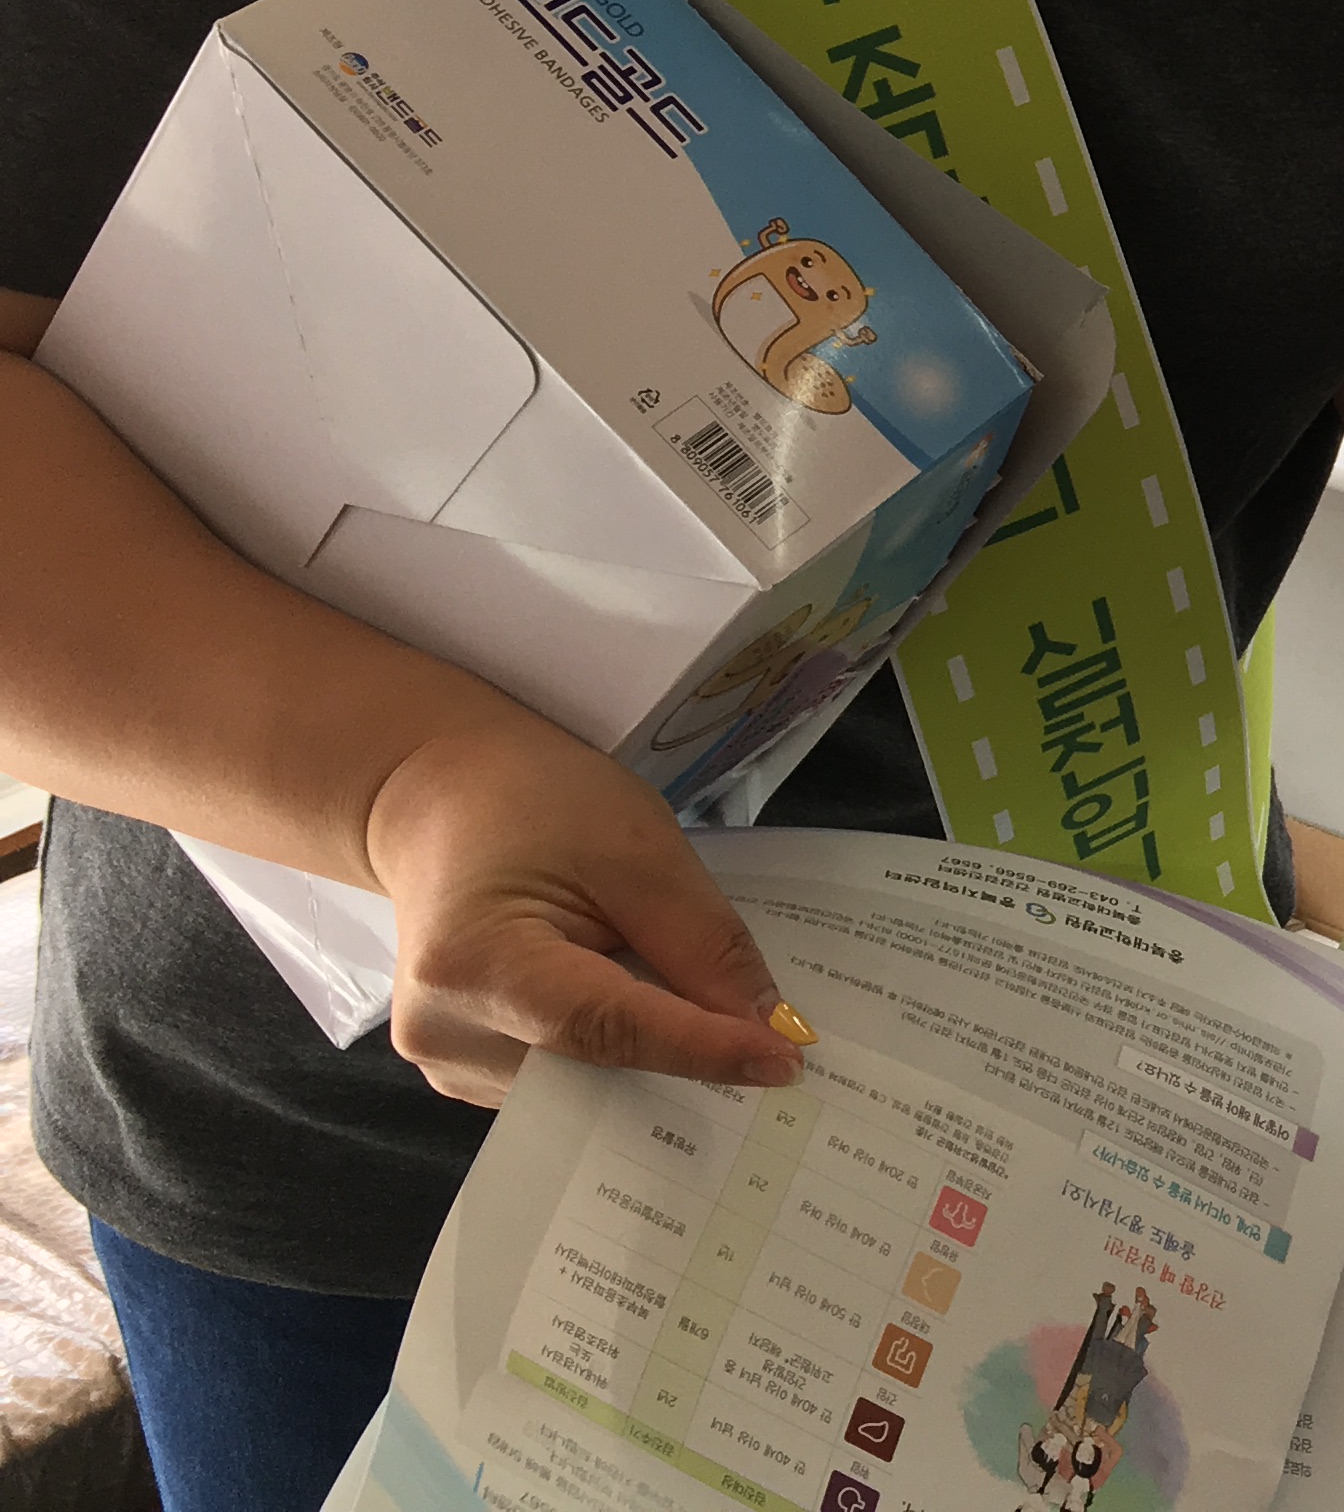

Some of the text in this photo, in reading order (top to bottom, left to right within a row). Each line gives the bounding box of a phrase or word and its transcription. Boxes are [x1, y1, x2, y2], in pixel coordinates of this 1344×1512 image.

[531, 46, 610, 126] BANDAGES
[669, 433, 759, 525] 8 809057 761061
[939, 852, 982, 872] 6567
[883, 864, 1017, 911] 충북지역암센터
[936, 861, 1144, 927] 충북대학교병원 건강검진센터
[1059, 911, 1189, 966] 충북대학교병원
[772, 1107, 798, 1130] 2년
[1057, 1076, 1147, 1126] 2단계 검진은
[1132, 1058, 1293, 1142] 어떻게 해야 받을 수 있나요?
[646, 1121, 700, 1160] 유방촬영
[1094, 1112, 1240, 1194] 안내문을 받으신 해당연도 12월
[1127, 1091, 1273, 1170] 국민건강보험공단에서 보내드린
[745, 1170, 771, 1194] 2년
[824, 1132, 907, 1183] 20세 이상 여성
[592, 1179, 690, 1240] 분변잠혈반응검사
[942, 1167, 996, 1203] 자궁경부암
[1089, 1142, 1265, 1242] 언제, 어디서 받을 수 있습니까?
[796, 1197, 880, 1251] 40세 이상 여성
[1057, 1178, 1199, 1263] 올해도 챙기십시오!
[714, 1242, 738, 1265] 1년
[926, 1237, 962, 1265] 유방암
[1099, 1233, 1230, 1312] 건강할 때 암검진!
[566, 1267, 653, 1322] 복부초음파검사
[765, 1269, 850, 1323] 50세 이상 남녀
[547, 1312, 623, 1361] 위장조영검사
[674, 1312, 713, 1342] 6개월
[744, 1330, 785, 1360] 해당자
[897, 1308, 933, 1336] 대장암
[535, 1340, 613, 1391] 위내시경검사
[564, 1338, 595, 1364] 또는
[758, 1356, 810, 1392] 간암발생
[540, 1374, 592, 1410] 검진방법
[653, 1386, 680, 1410] 2년
[735, 1363, 822, 1417] 40세 이상 남녀
[873, 1384, 900, 1408] 간암
[625, 1422, 678, 1458] 검진주기
[706, 1414, 794, 1469] 40세 이상 남녀
[718, 1472, 770, 1507] 검진대상
[847, 1458, 873, 1481] 위암
